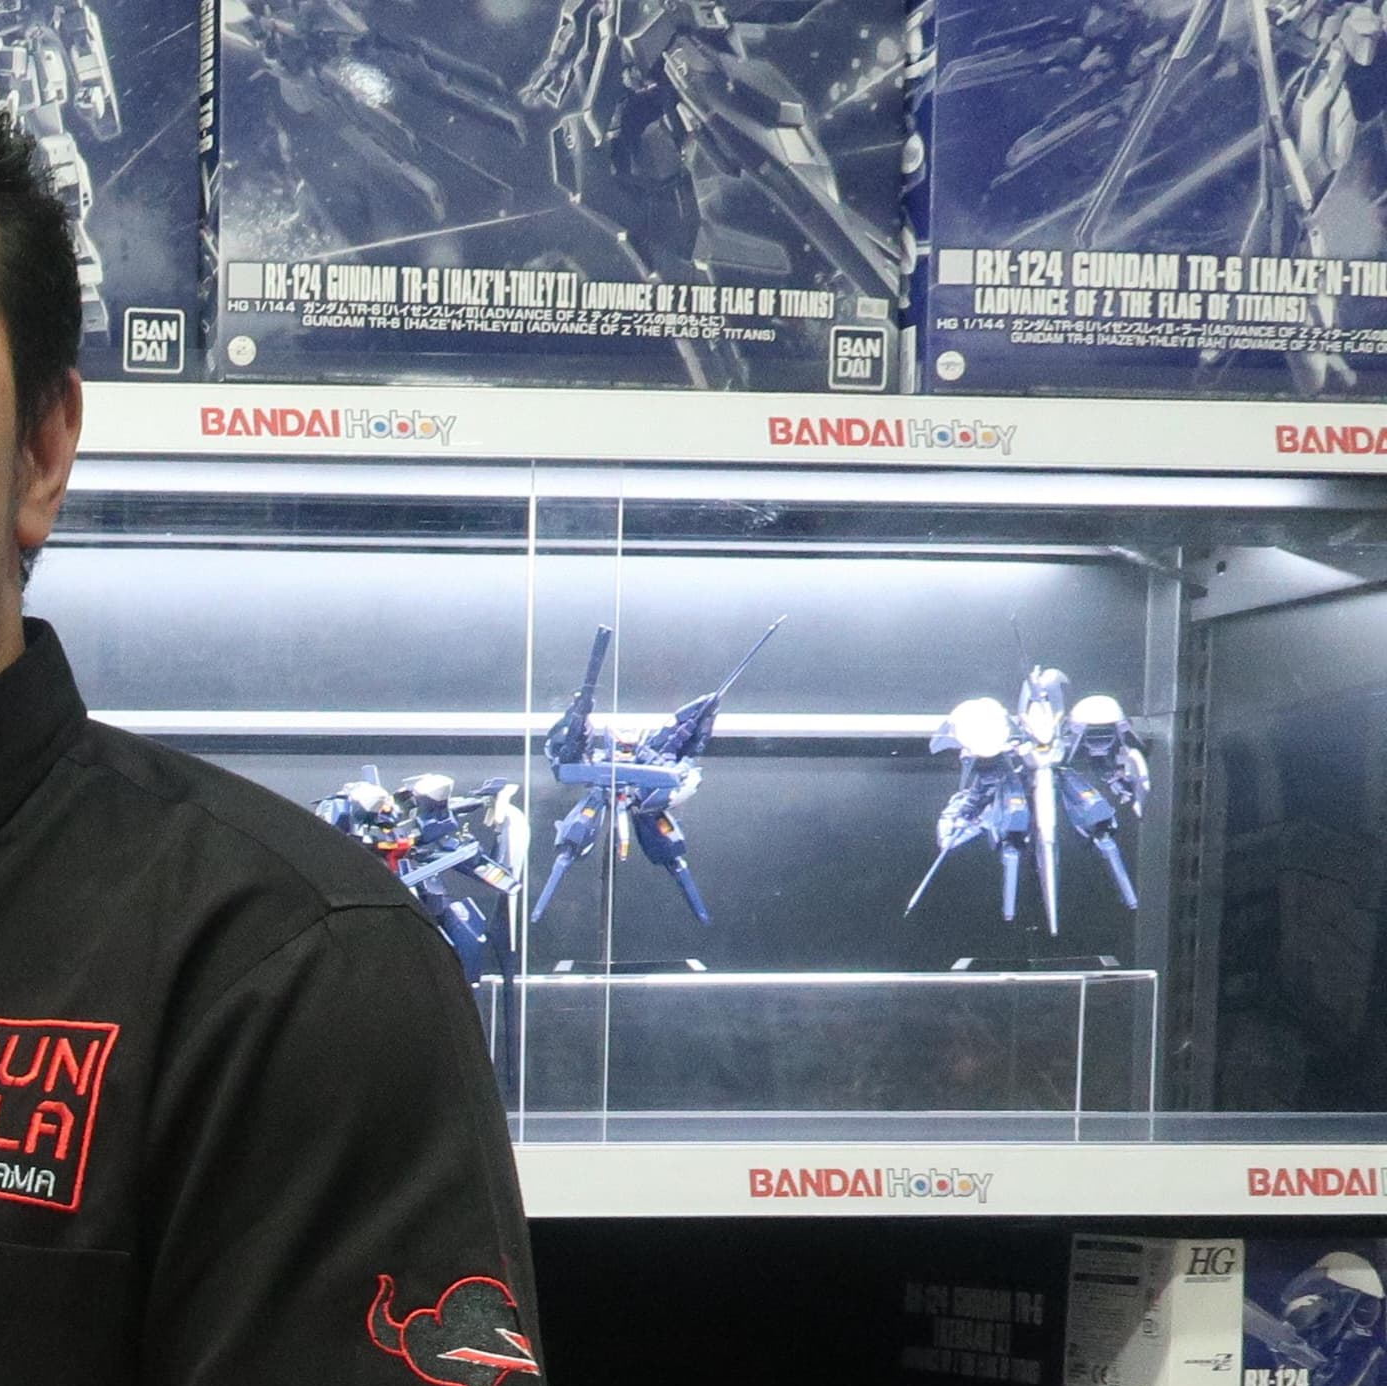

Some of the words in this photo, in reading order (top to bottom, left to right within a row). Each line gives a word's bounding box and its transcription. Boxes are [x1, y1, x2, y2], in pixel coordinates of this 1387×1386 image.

[974, 249, 1064, 287] RX-124
[1072, 252, 1180, 291] GUNDAM
[1187, 255, 1243, 293] TR-6
[264, 263, 322, 300] RX-124
[326, 265, 397, 303] GUNDAM
[401, 267, 440, 304] TR-6
[582, 282, 654, 312] (ADVANCE
[657, 284, 676, 312] OF
[678, 285, 688, 314] Z
[691, 286, 718, 315] THE
[721, 287, 755, 317] FLAG
[758, 288, 777, 318] OF
[974, 287, 1070, 316] (ADVANCE
[1074, 289, 1099, 317] OF
[1102, 290, 1114, 318] Z
[1120, 291, 1153, 319] THE
[1158, 292, 1203, 320] FLAG
[1207, 293, 1230, 321] OF
[227, 300, 249, 313] HG
[254, 300, 296, 313] 1/144
[131, 319, 178, 341] BAN
[131, 340, 170, 362] DAI
[837, 337, 882, 358] BAN
[837, 357, 872, 378] DAI
[201, 407, 341, 438] BANDAI
[344, 408, 457, 446] Hobby
[768, 417, 905, 448] BANDAI
[908, 419, 1017, 456] Hobby
[1275, 425, 1387, 455] BANDA
[749, 1168, 883, 1198] BANDAI
[886, 1168, 994, 1203] Hobby
[1248, 1167, 1378, 1197] BANDAI
[1184, 1247, 1235, 1276] HG
